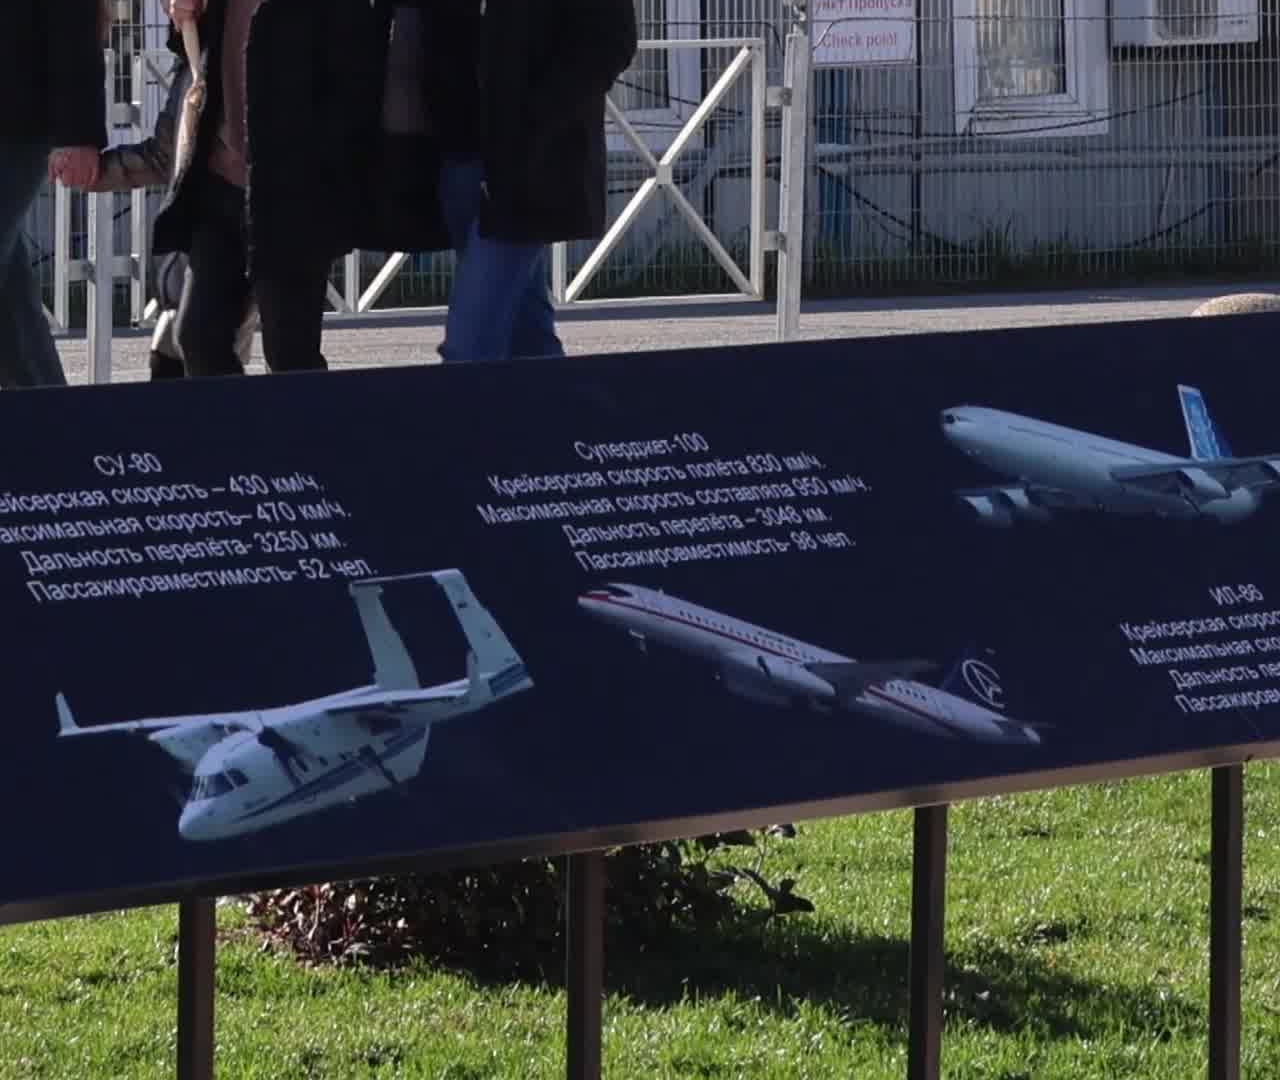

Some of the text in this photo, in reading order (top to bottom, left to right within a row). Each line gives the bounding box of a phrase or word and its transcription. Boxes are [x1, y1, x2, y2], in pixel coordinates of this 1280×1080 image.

[93, 452, 162, 476] СУ-80
[574, 432, 709, 464] Суперджет-100
[111, 484, 208, 507] скорость
[230, 474, 269, 496] 430
[488, 451, 826, 499] Крейсерская скорость полёта 830 км/ч.
[257, 501, 296, 523] 470
[477, 474, 872, 524] Максимальная скорость составляла 950 км/ч.
[562, 522, 661, 547] Дальность
[660, 512, 745, 538] перелёта
[755, 505, 802, 526] 3048
[802, 507, 832, 522] км.
[20, 530, 347, 576] Дальность перелёта- 3250 км.
[574, 530, 856, 571] Пассажировместимость- 98 чел.
[26, 558, 378, 602] Пассажировместимость- 52 чел.
